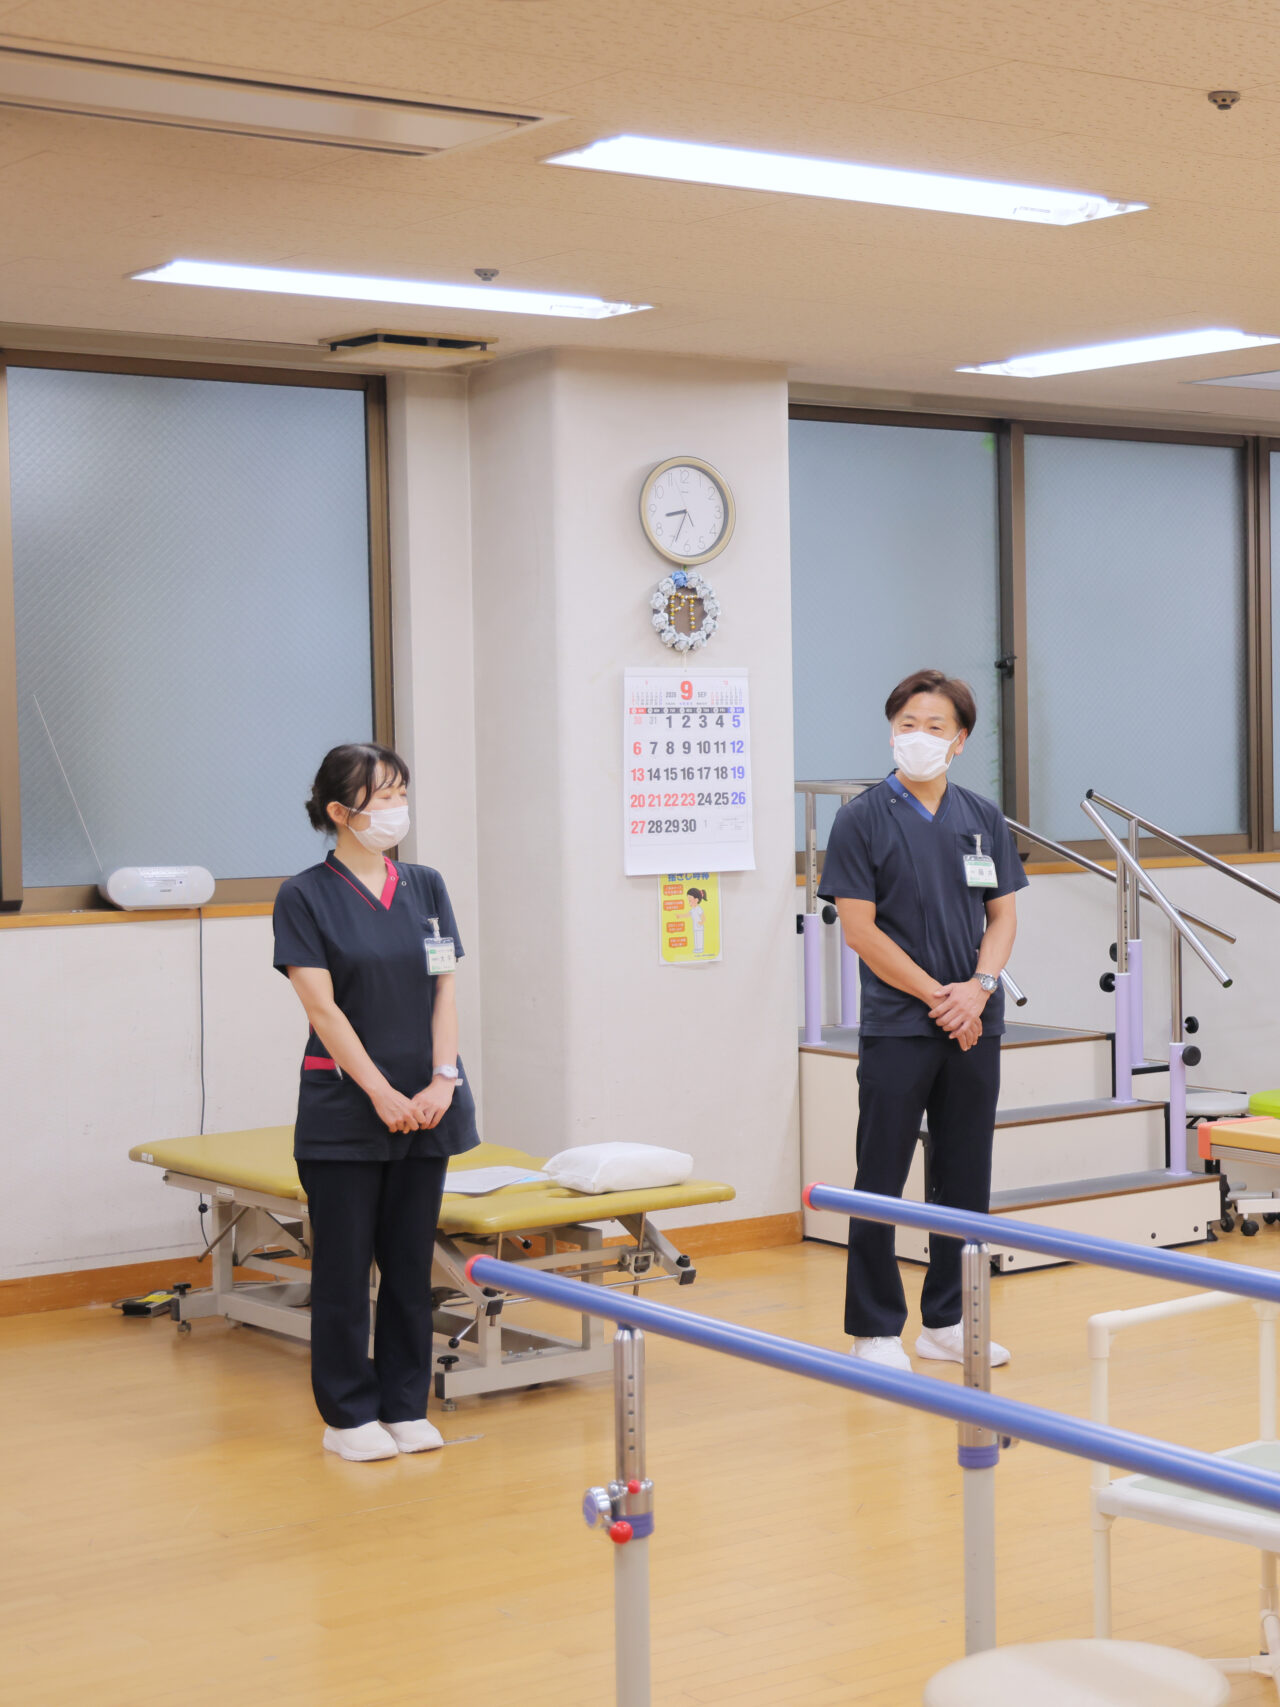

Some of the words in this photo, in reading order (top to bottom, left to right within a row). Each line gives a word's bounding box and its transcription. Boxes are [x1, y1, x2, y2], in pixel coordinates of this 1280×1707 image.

[680, 470, 689, 484] 12
[654, 485, 664, 499] 10
[708, 487, 716, 500] 2
[649, 503, 657, 518] 9
[714, 505, 722, 519] 3
[656, 522, 663, 536] 8
[709, 523, 719, 537] 4
[684, 539, 691, 552] 6
[698, 536, 706, 550] 5
[680, 680, 693, 701] 9
[665, 715, 673, 728] 1
[682, 715, 691, 728] 2
[699, 715, 708, 728] 3
[715, 715, 725, 728] 4
[732, 714, 741, 728] 5
[633, 742, 642, 755] 6
[650, 742, 658, 754] 7
[666, 741, 675, 755] 8
[682, 741, 691, 754] 9
[697, 740, 711, 754] 10
[714, 740, 726, 754] 11
[730, 740, 744, 753] 12
[631, 768, 645, 781] 13
[647, 767, 661, 781] 14
[664, 767, 677, 781] 15
[680, 767, 694, 780] 16
[697, 766, 711, 780] 17
[714, 766, 728, 779] 18
[731, 766, 745, 779] 19
[630, 794, 646, 808] 20
[648, 794, 662, 807] 21
[664, 793, 679, 807] 22
[680, 793, 696, 807] 23
[697, 792, 712, 806] 24
[714, 792, 729, 805] 25
[731, 791, 746, 805] 26
[631, 820, 646, 834] 27
[648, 820, 662, 833] 28
[664, 819, 680, 833] 29
[681, 818, 697, 832] 30
